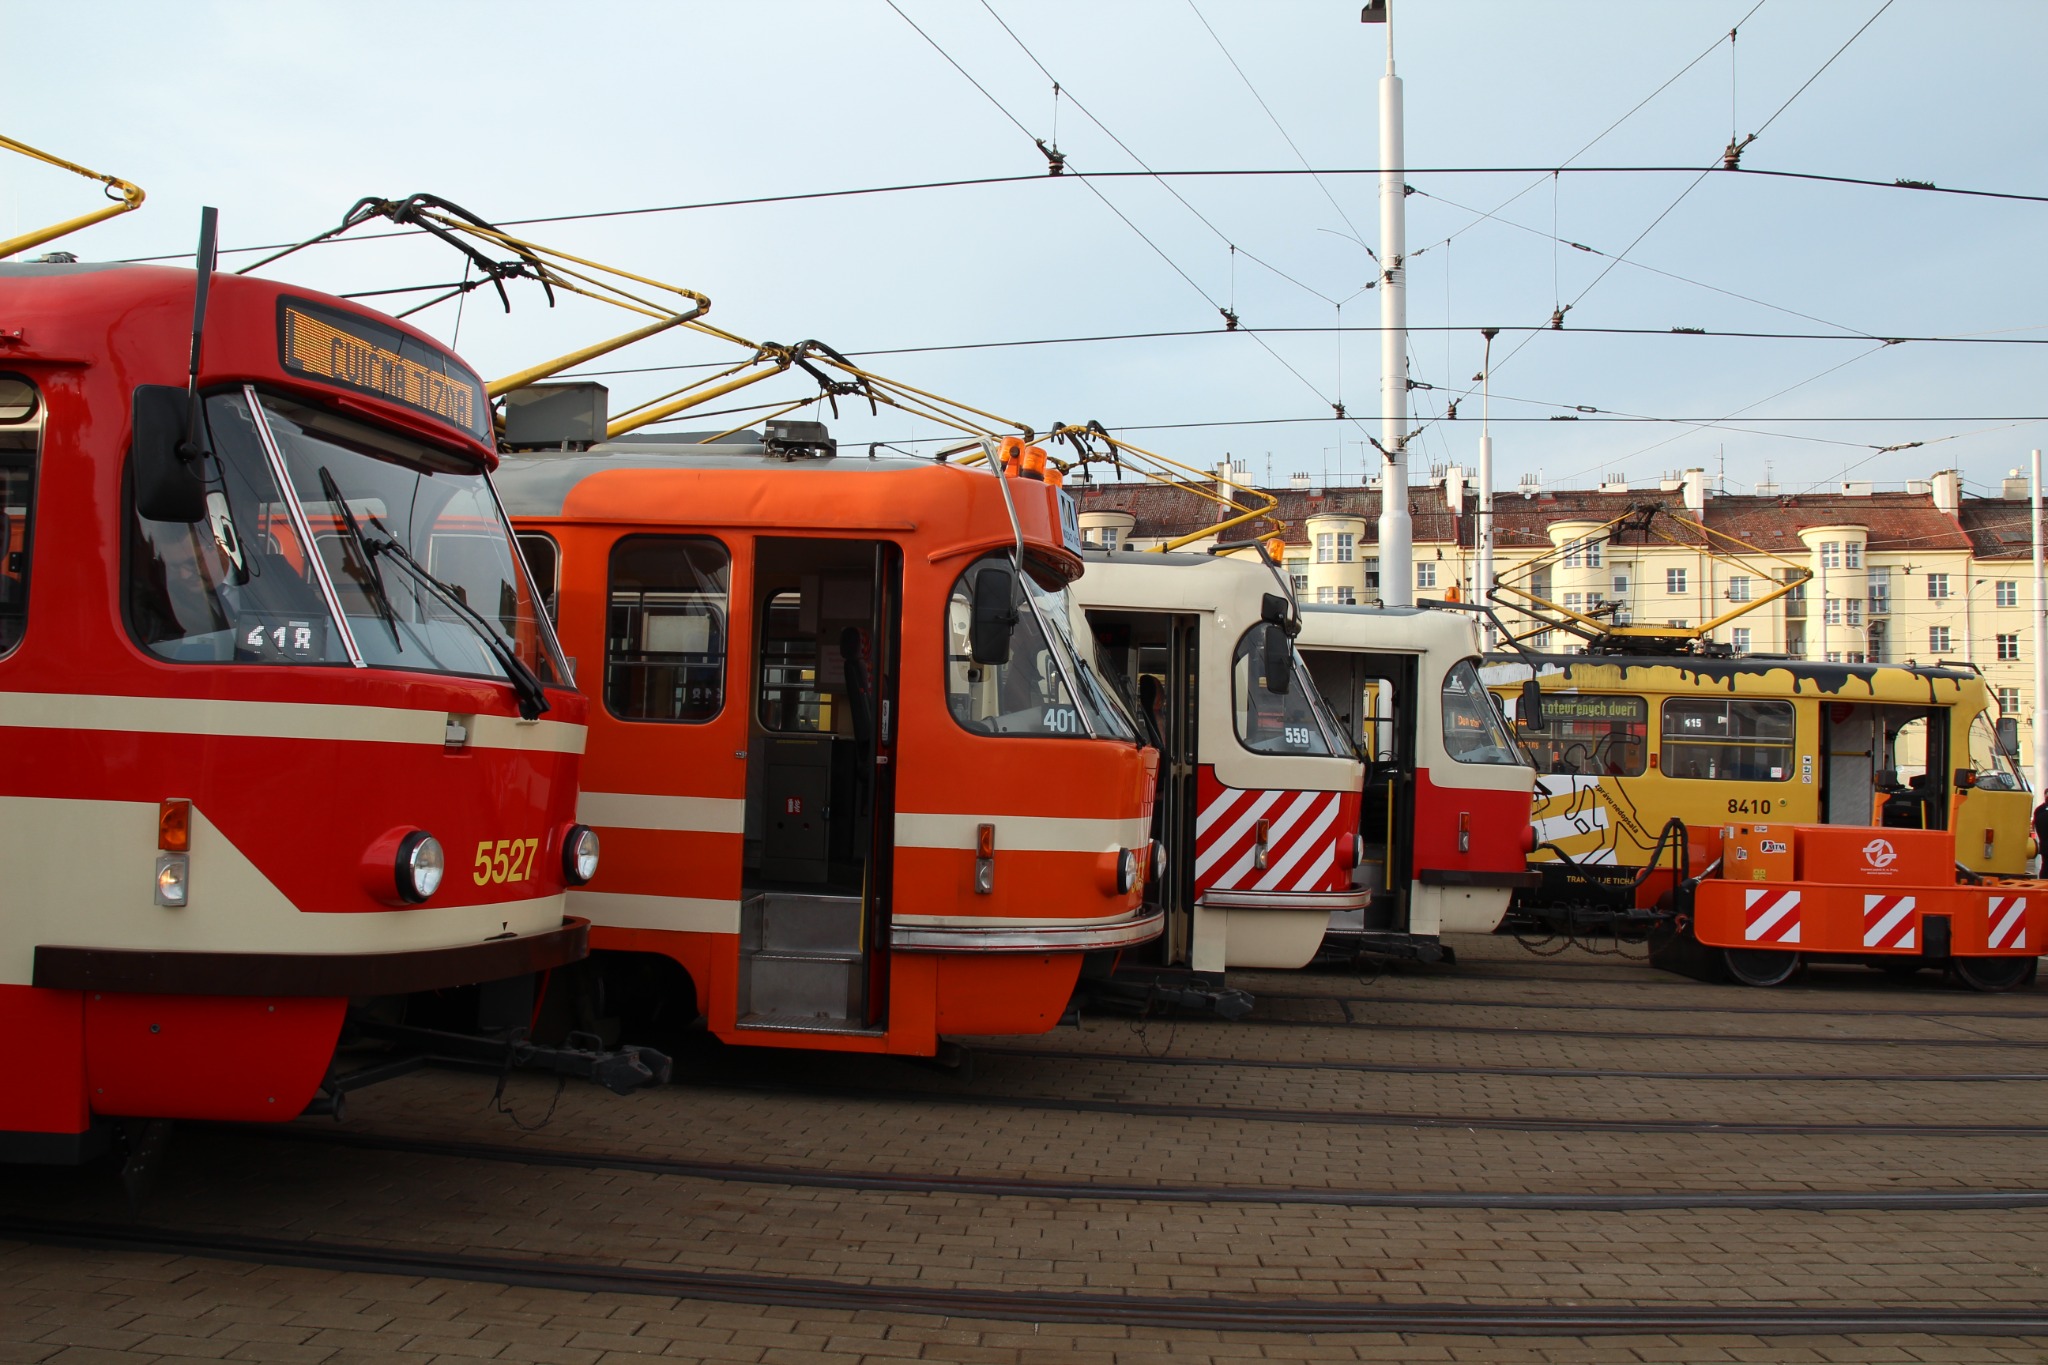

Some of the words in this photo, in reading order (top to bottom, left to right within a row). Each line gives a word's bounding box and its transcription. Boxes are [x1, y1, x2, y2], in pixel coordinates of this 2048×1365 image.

[1043, 708, 1076, 733] 401
[1284, 727, 1309, 744] 559
[1594, 784, 1614, 805] zprávu
[1612, 803, 1639, 834] nedopsala
[1727, 798, 1771, 815] 8410
[473, 838, 539, 887] 5527
